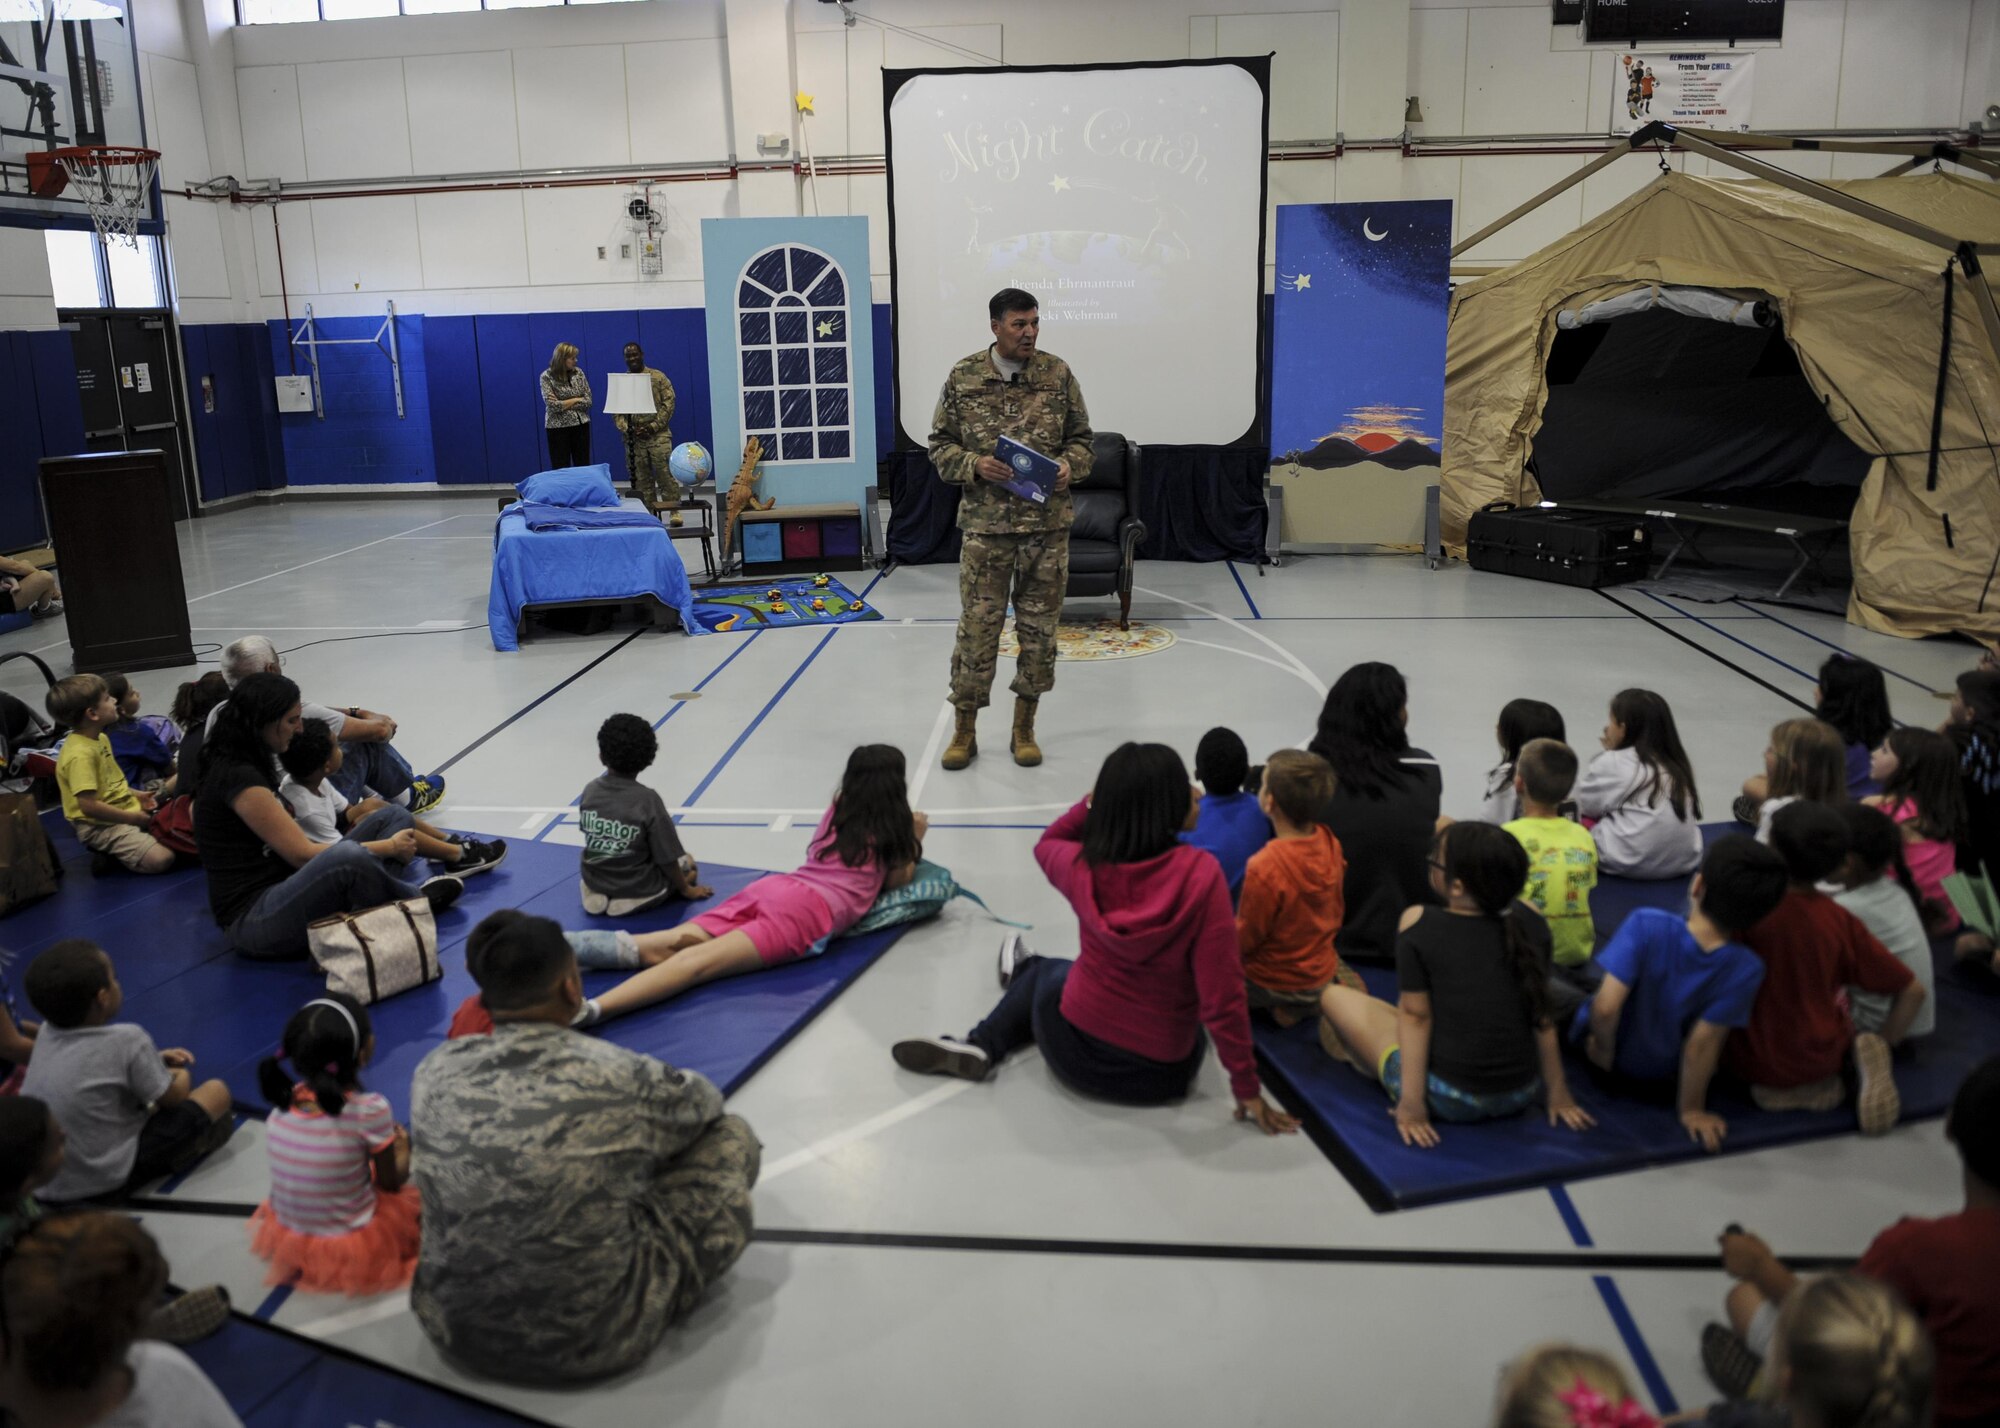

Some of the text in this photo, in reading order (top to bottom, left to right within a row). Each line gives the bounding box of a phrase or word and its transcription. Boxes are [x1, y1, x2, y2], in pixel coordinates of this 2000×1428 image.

[1678, 63, 1695, 71] From
[1696, 63, 1711, 71] Your
[940, 107, 1208, 185] Night Catch
[1010, 277, 1136, 290] Brenda Ehrmantraut
[1047, 297, 1101, 308] Illustrated by
[1038, 309, 1117, 321] icki Wehrman
[582, 810, 640, 842] lligator
[587, 834, 630, 854] lass
